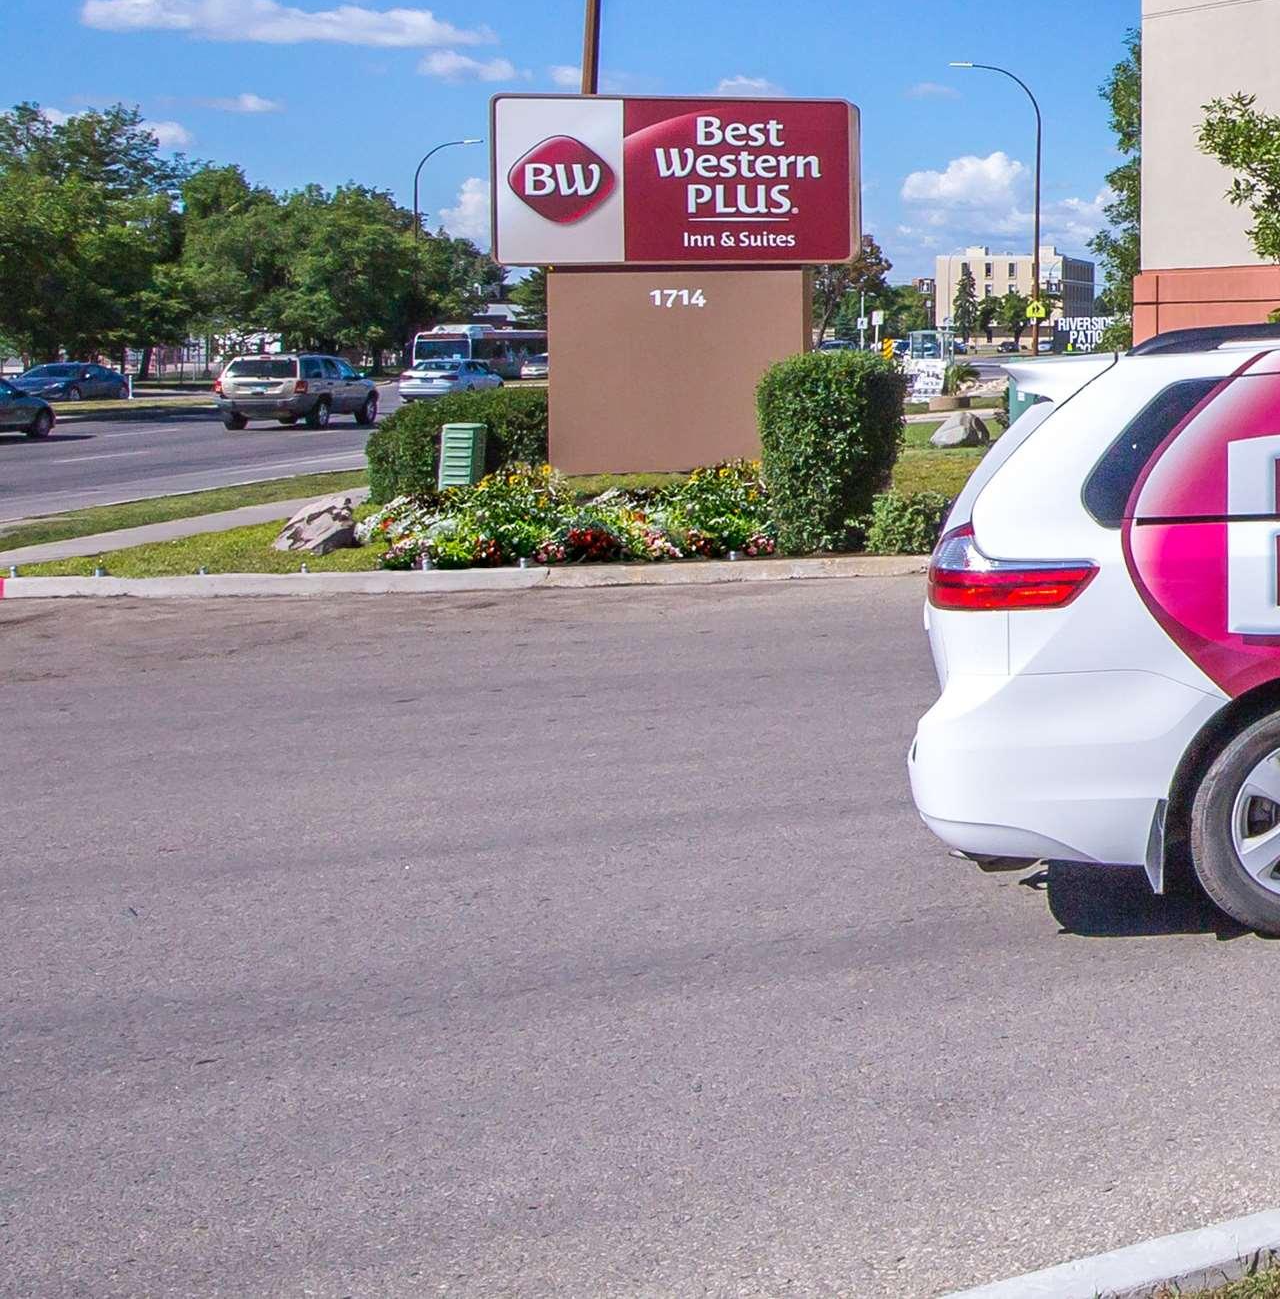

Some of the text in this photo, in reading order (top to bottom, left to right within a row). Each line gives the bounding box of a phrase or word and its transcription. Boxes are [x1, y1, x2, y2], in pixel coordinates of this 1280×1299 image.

[696, 116, 785, 147] Best
[655, 147, 822, 179] Western
[523, 162, 601, 197] BW
[687, 184, 793, 214] PLUS
[683, 231, 796, 247] Inn & Suites
[650, 289, 707, 309] 1714
[1069, 329, 1104, 344] PATIO
